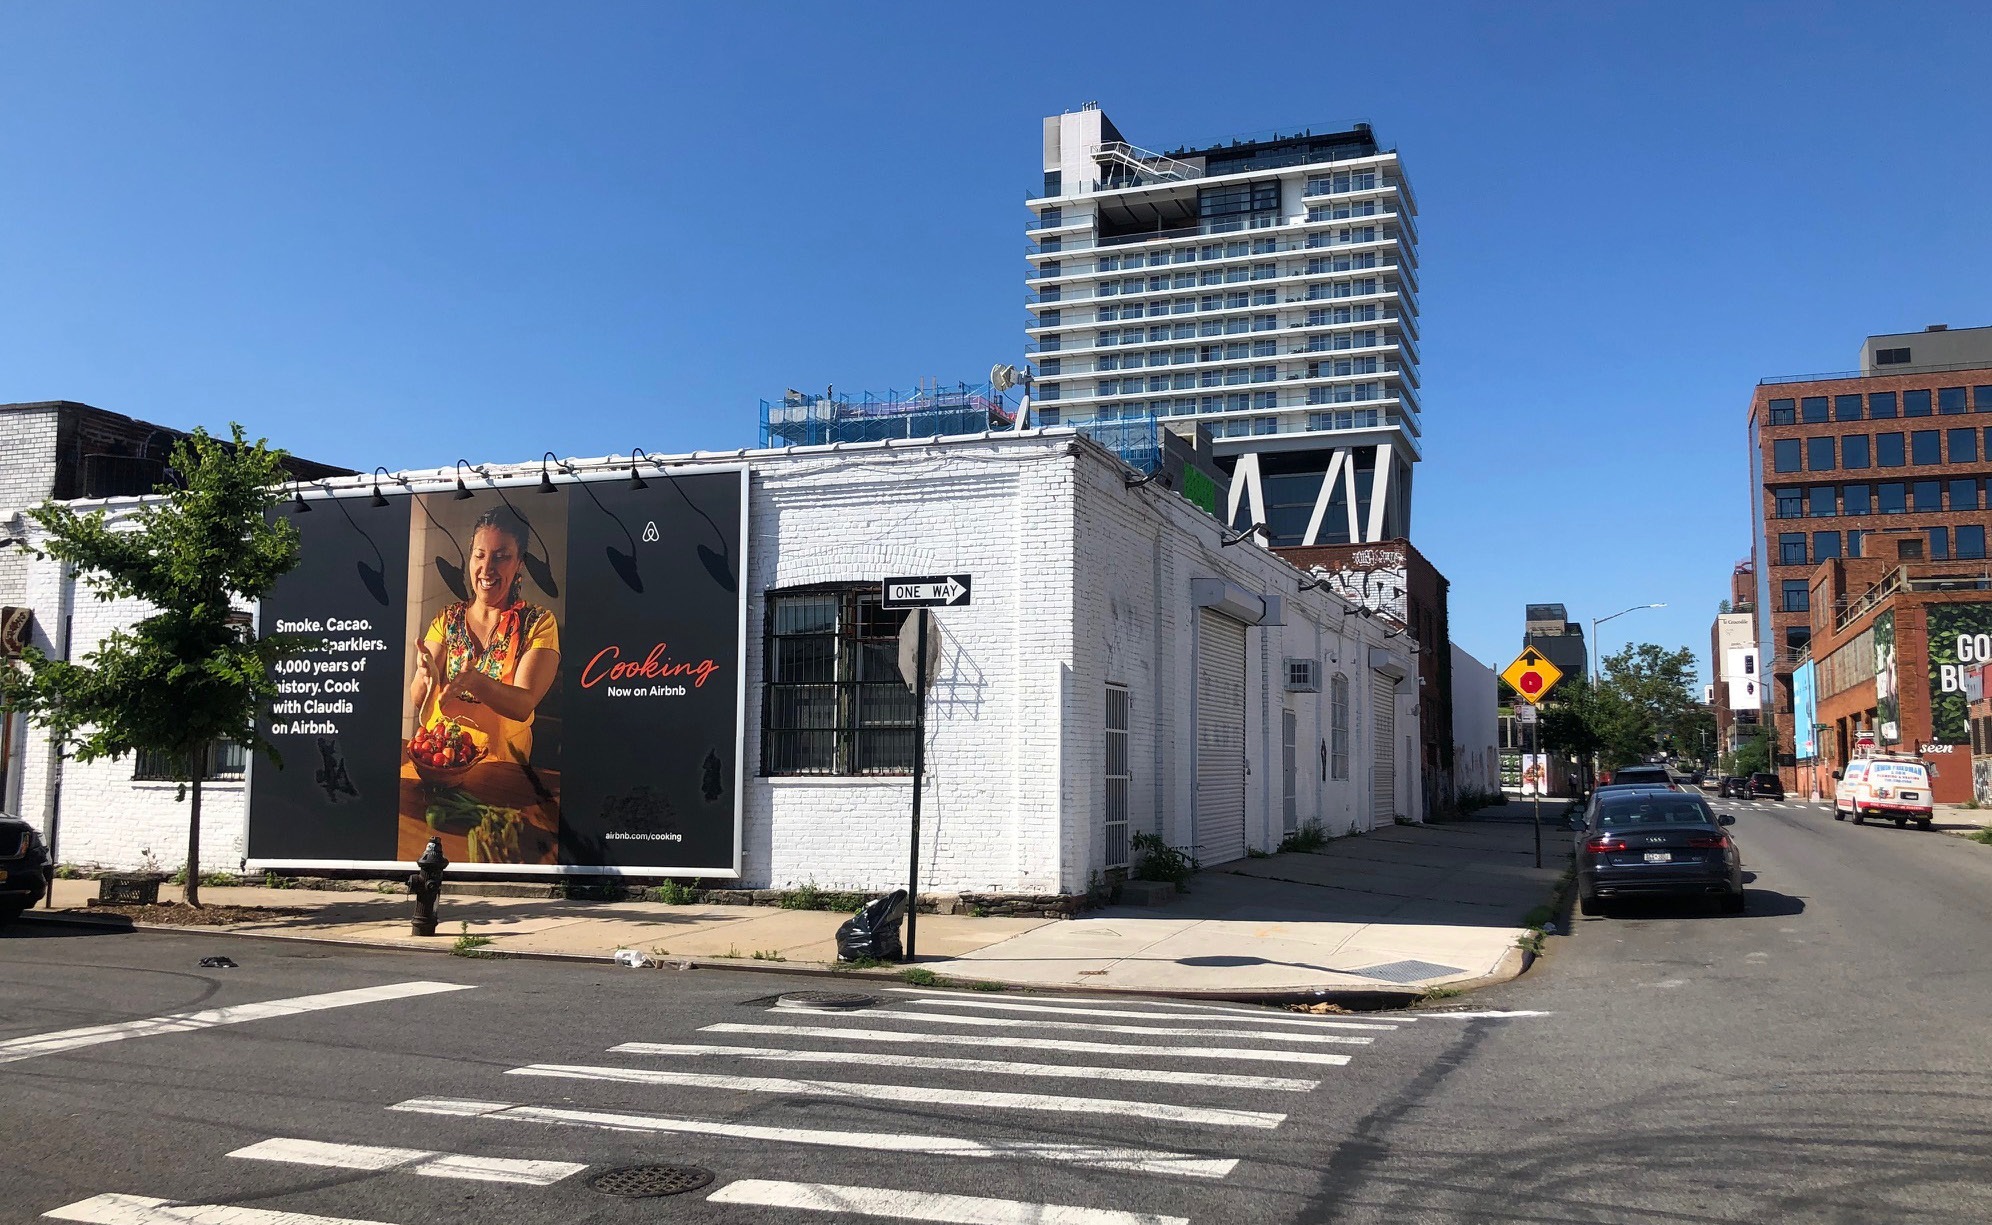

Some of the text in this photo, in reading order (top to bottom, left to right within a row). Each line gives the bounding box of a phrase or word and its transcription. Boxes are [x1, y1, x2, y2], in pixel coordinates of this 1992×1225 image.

[896, 584, 959, 599] ONE WAY
[276, 617, 372, 633] Smoke. Cacao.
[321, 637, 388, 655] Sparklers.
[1956, 633, 1992, 662] GO
[274, 657, 367, 676] 4,000 years of
[580, 642, 720, 689] Cooking
[324, 678, 360, 693] Cook
[607, 684, 687, 697] Now on Airbnb
[273, 699, 354, 714] with Claudia
[271, 720, 339, 735] on Airbnb.
[1919, 743, 1954, 754] seen
[605, 831, 682, 843] airbnb.com/cooking
